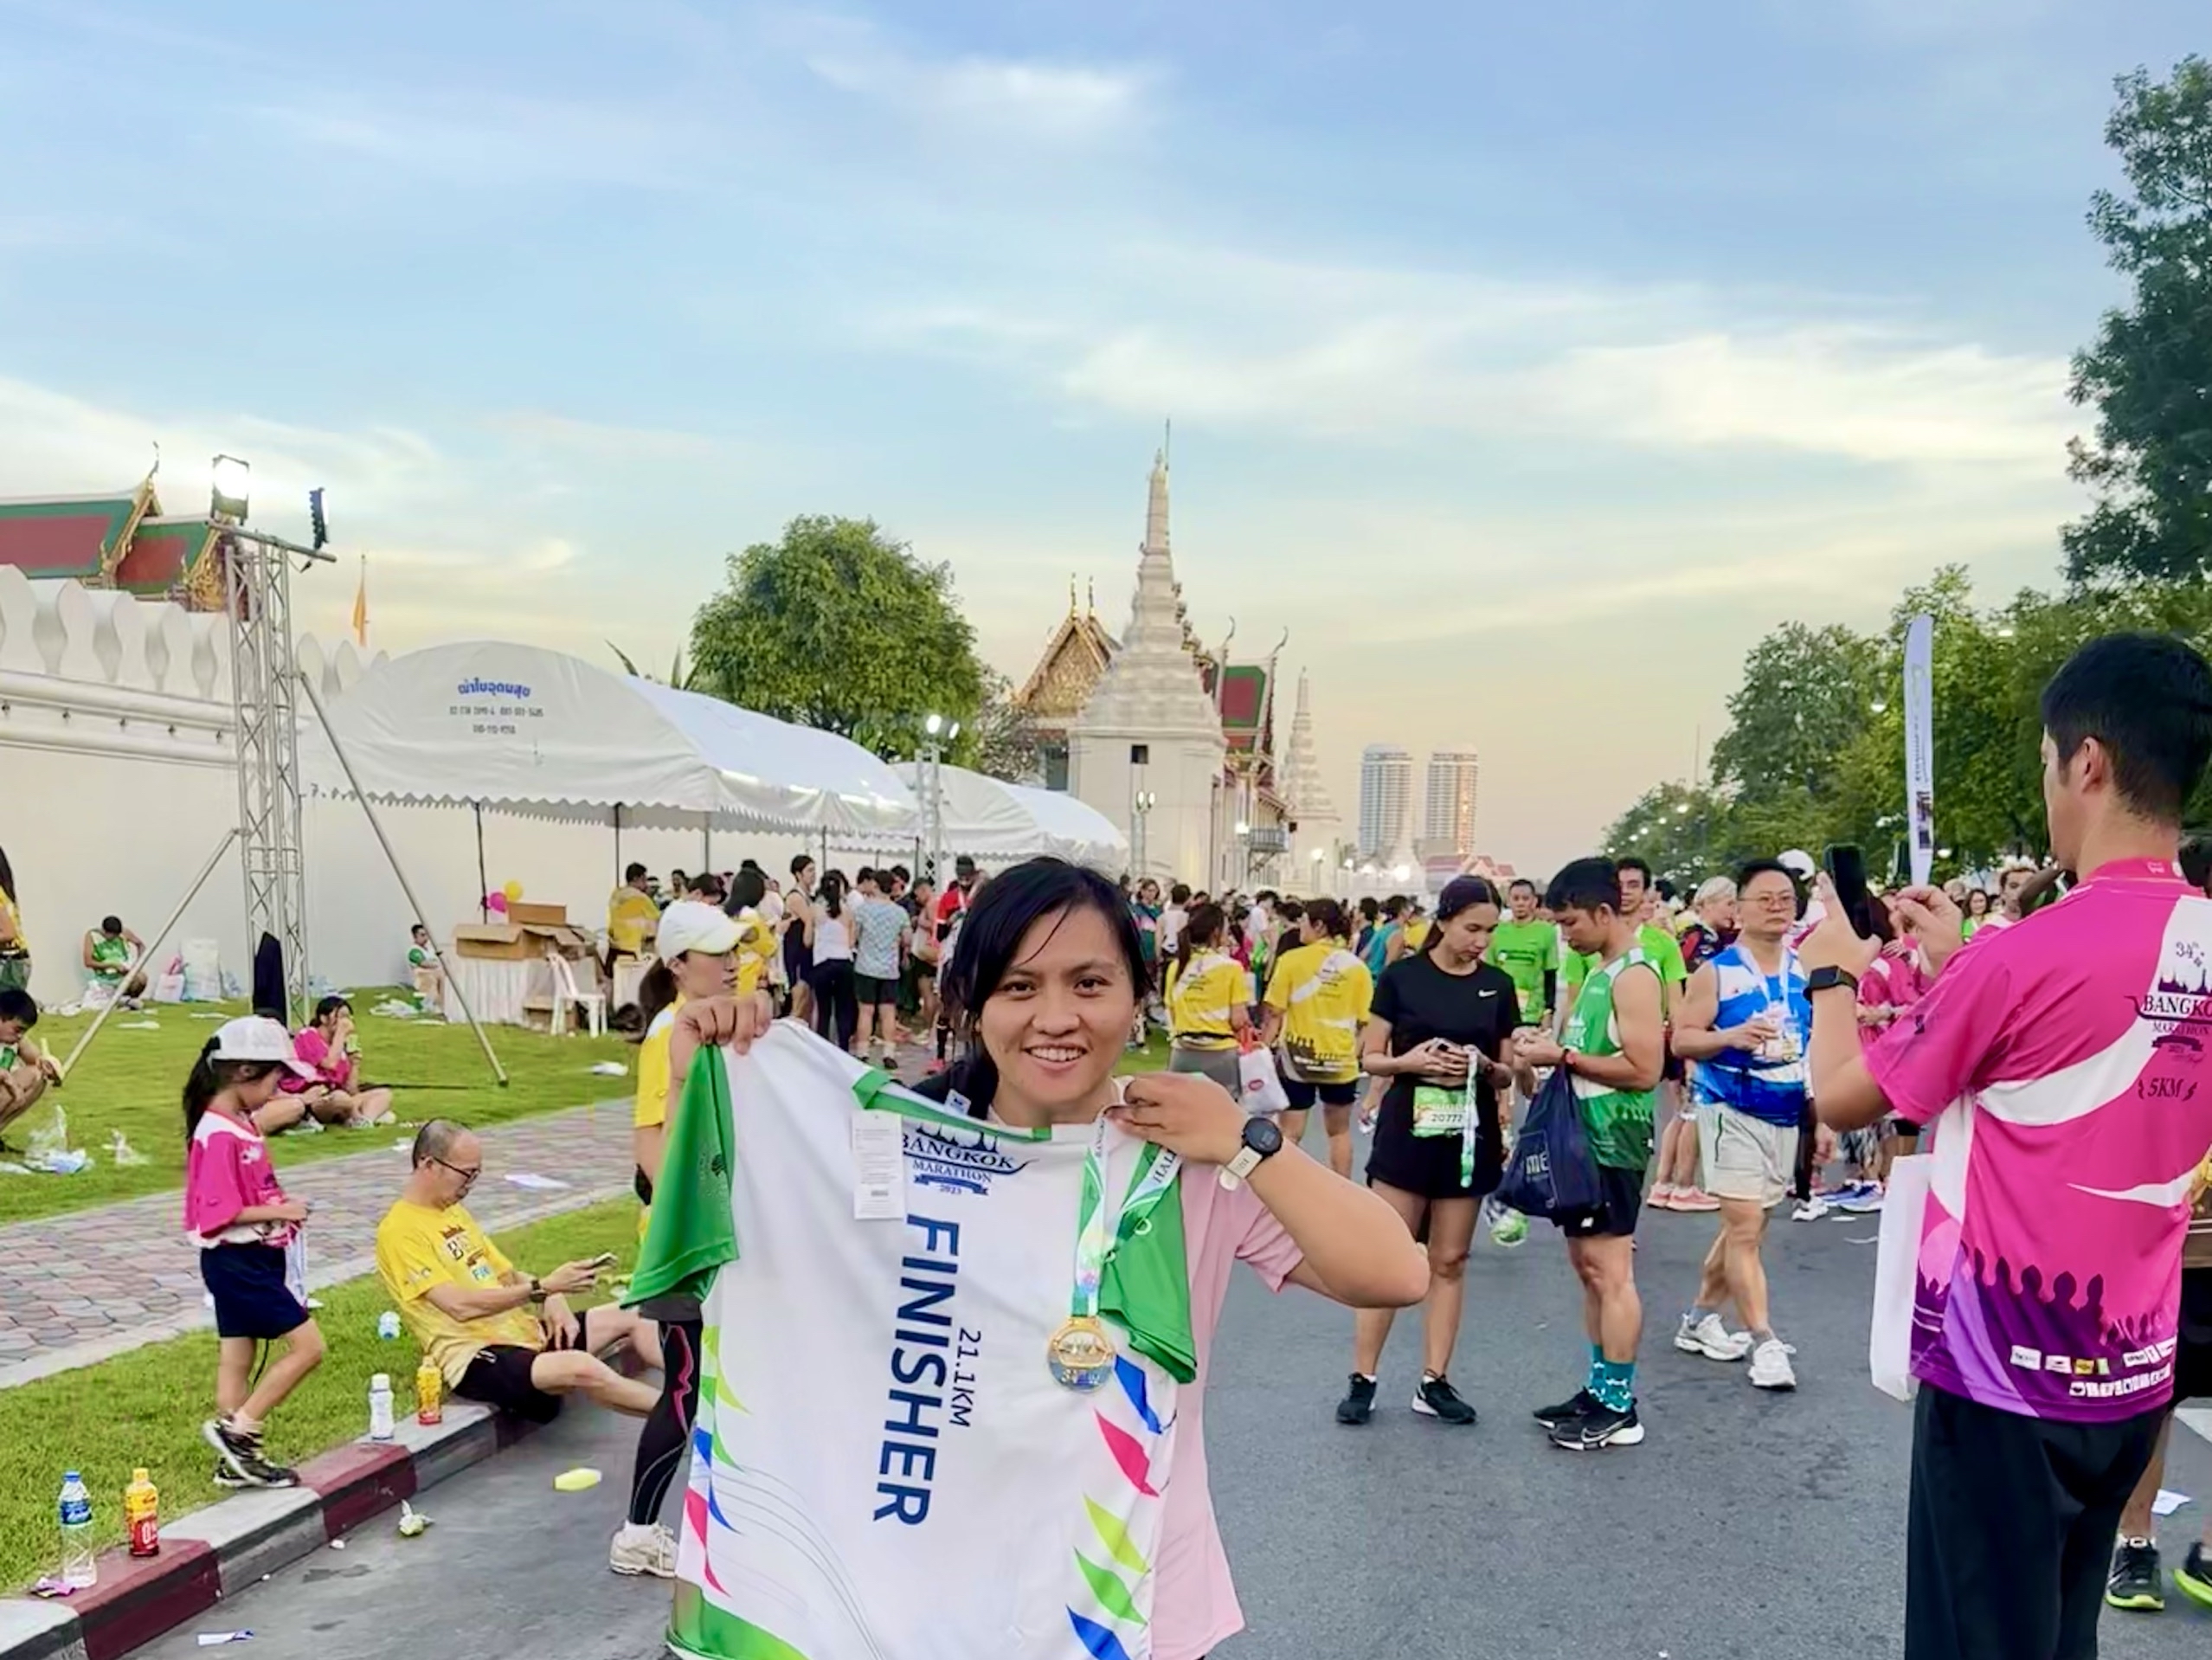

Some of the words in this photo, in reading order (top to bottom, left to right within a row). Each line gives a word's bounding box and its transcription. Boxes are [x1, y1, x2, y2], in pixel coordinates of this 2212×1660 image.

[2144, 995, 2212, 1020] BANGKO
[2148, 1078, 2184, 1097] 5KM
[913, 1160, 992, 1183] MARATHON
[873, 1213, 960, 1525] FINISHER
[948, 1327, 981, 1428] 21.1KM
